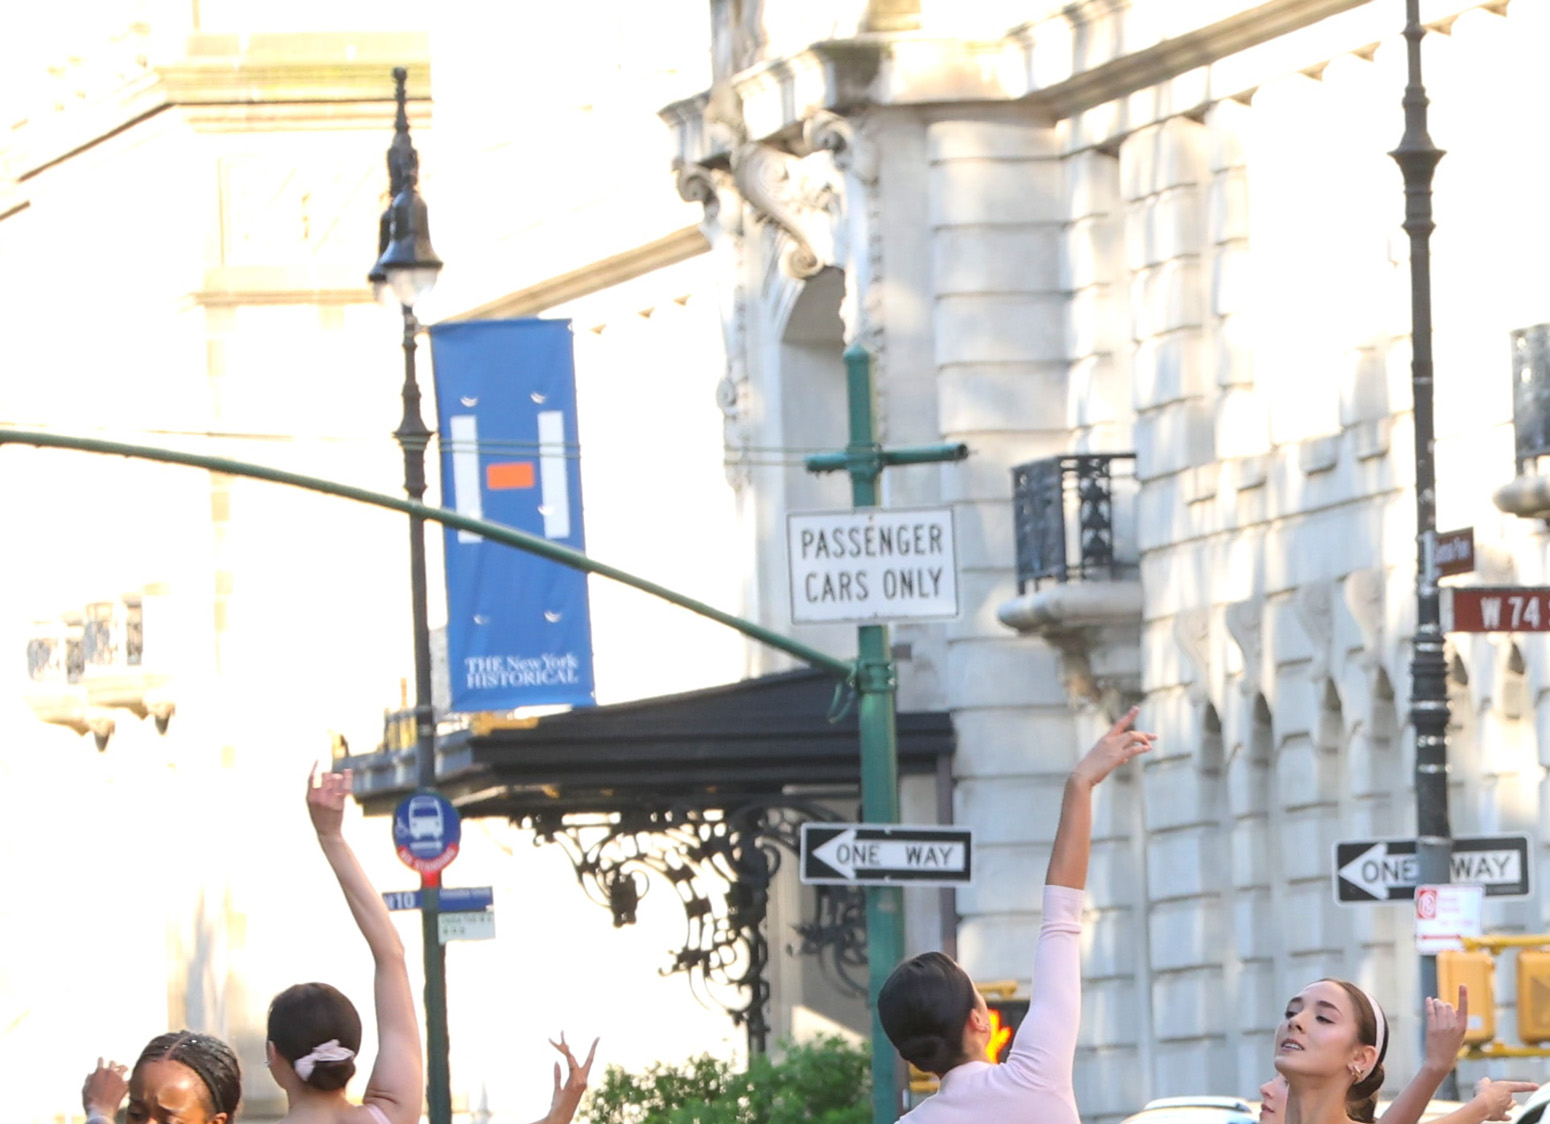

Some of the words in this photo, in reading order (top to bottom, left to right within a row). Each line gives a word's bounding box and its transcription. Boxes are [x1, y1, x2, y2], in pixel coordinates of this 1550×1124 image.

[801, 523, 943, 560] PASSENGER
[805, 571, 869, 603] CARS
[883, 567, 943, 600] ONLY
[1480, 597, 1502, 629] W
[1508, 596, 1541, 629] 74
[464, 656, 503, 674] THE
[506, 656, 540, 673] New
[541, 652, 578, 670] York
[466, 668, 579, 689] HISTORICAL
[835, 843, 881, 866] ONE
[905, 845, 953, 867] WAY
[1361, 858, 1418, 884] ONE
[1451, 854, 1511, 879] WAY
